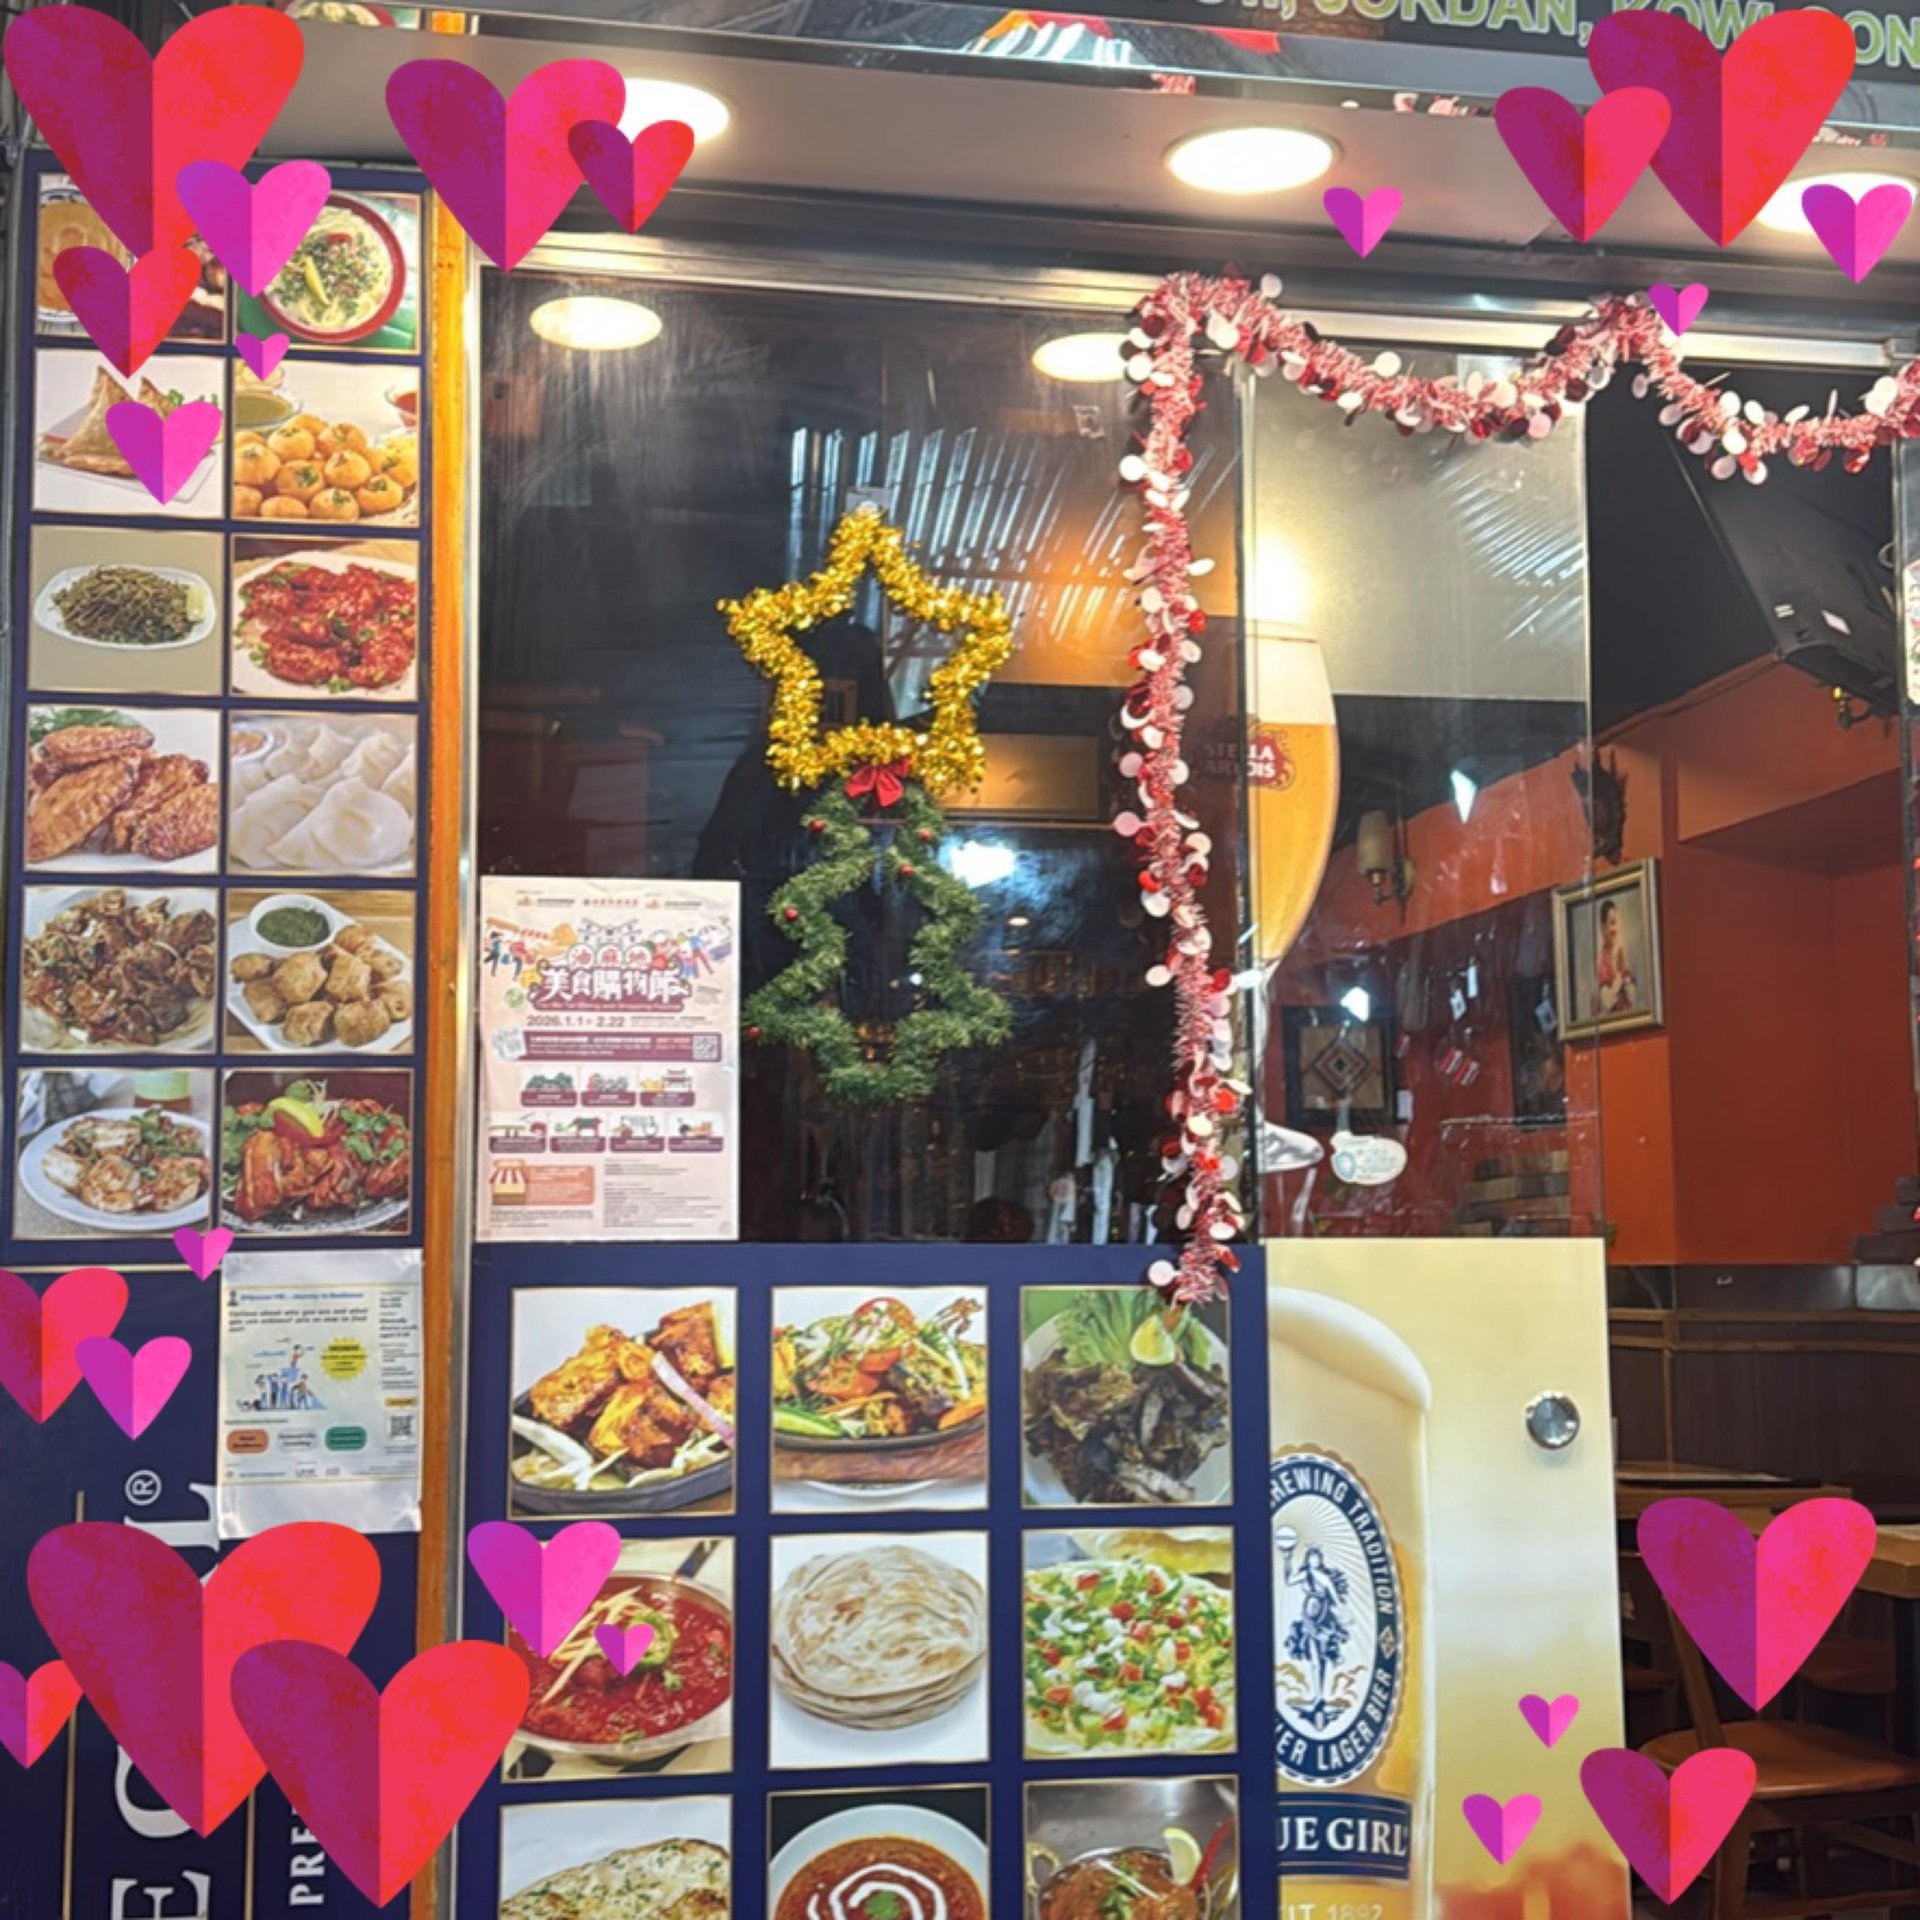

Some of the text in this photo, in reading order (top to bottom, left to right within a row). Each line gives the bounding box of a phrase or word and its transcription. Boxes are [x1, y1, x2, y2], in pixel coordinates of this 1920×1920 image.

[1271, 1467, 1394, 1615] REWING TRADITION
[1318, 1720, 1375, 1771] LAGER
[1366, 1667, 1392, 1723] BIER
[288, 1806, 326, 1906] PRE
[1326, 1816, 1407, 1858] GIRL
